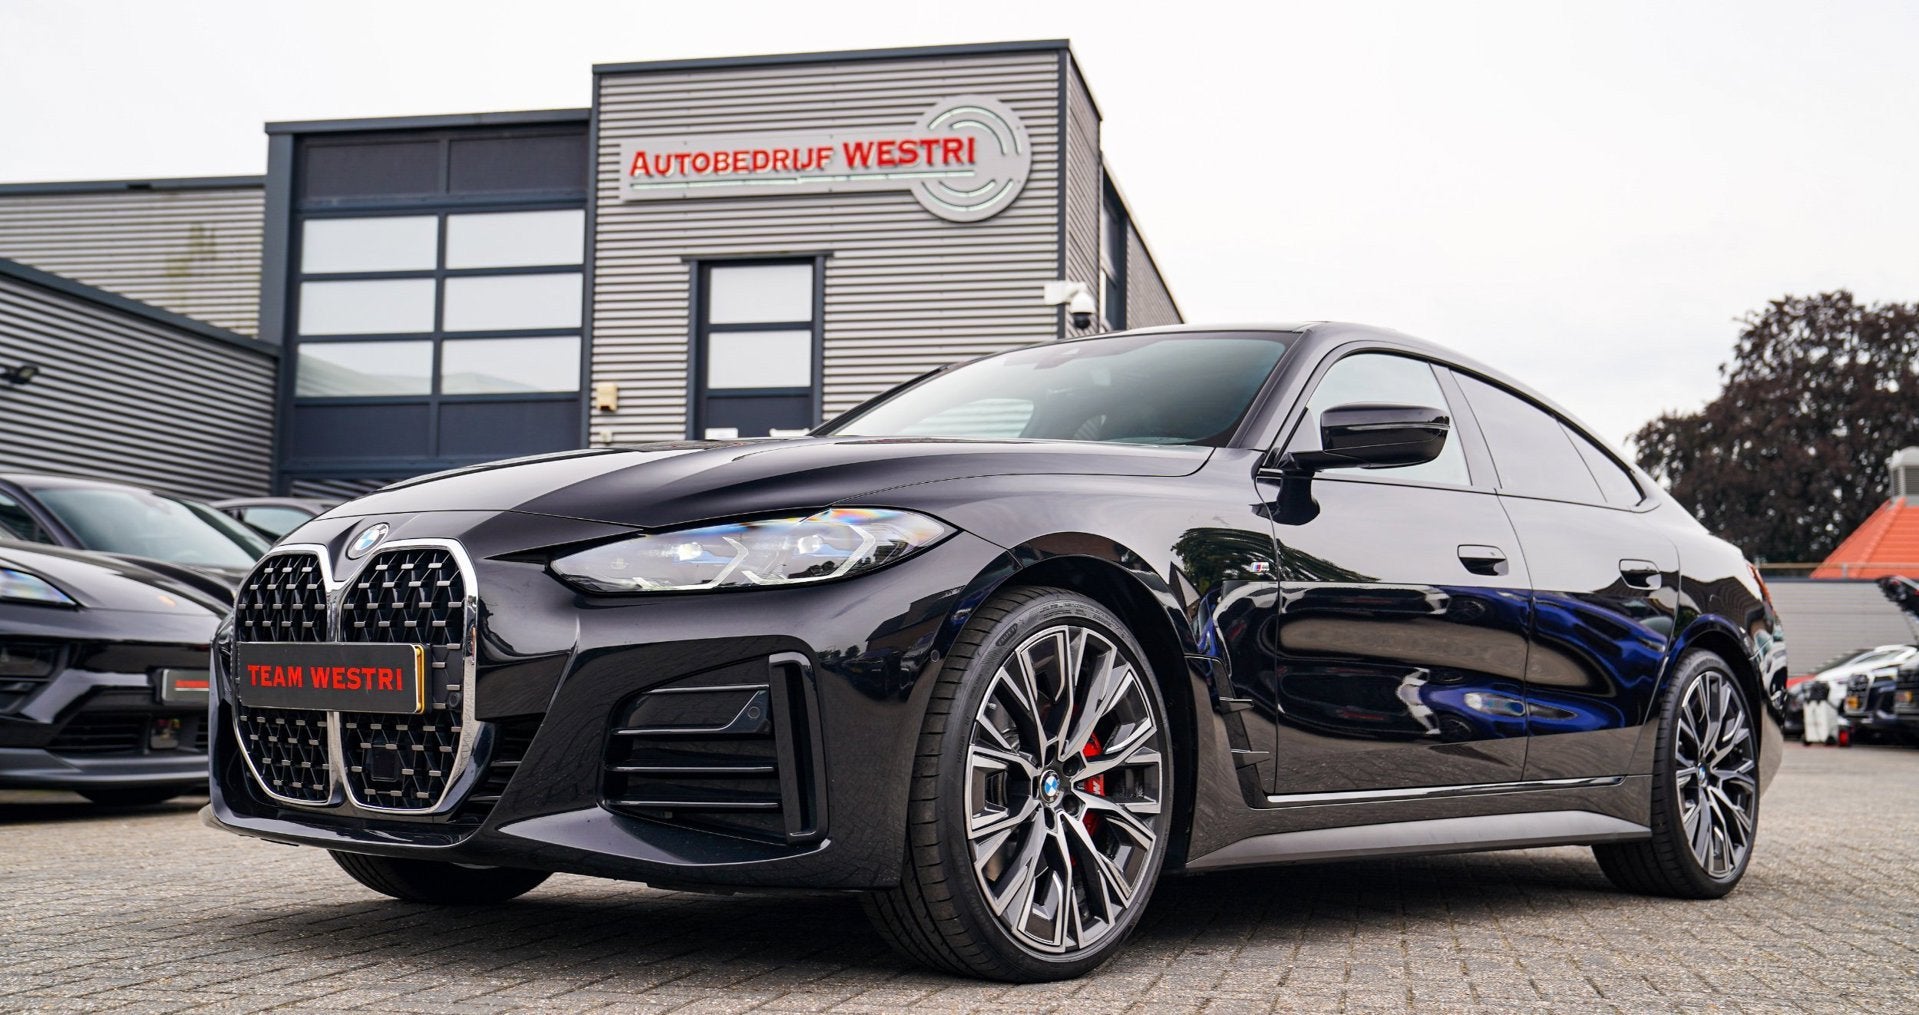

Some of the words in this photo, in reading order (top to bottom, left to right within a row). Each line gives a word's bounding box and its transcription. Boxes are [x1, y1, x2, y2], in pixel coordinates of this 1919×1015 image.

[629, 146, 834, 177] AUTOBEDRIJF
[842, 136, 976, 168] WESTRI
[247, 664, 304, 689] TEAM
[310, 666, 404, 691] WESTRI
